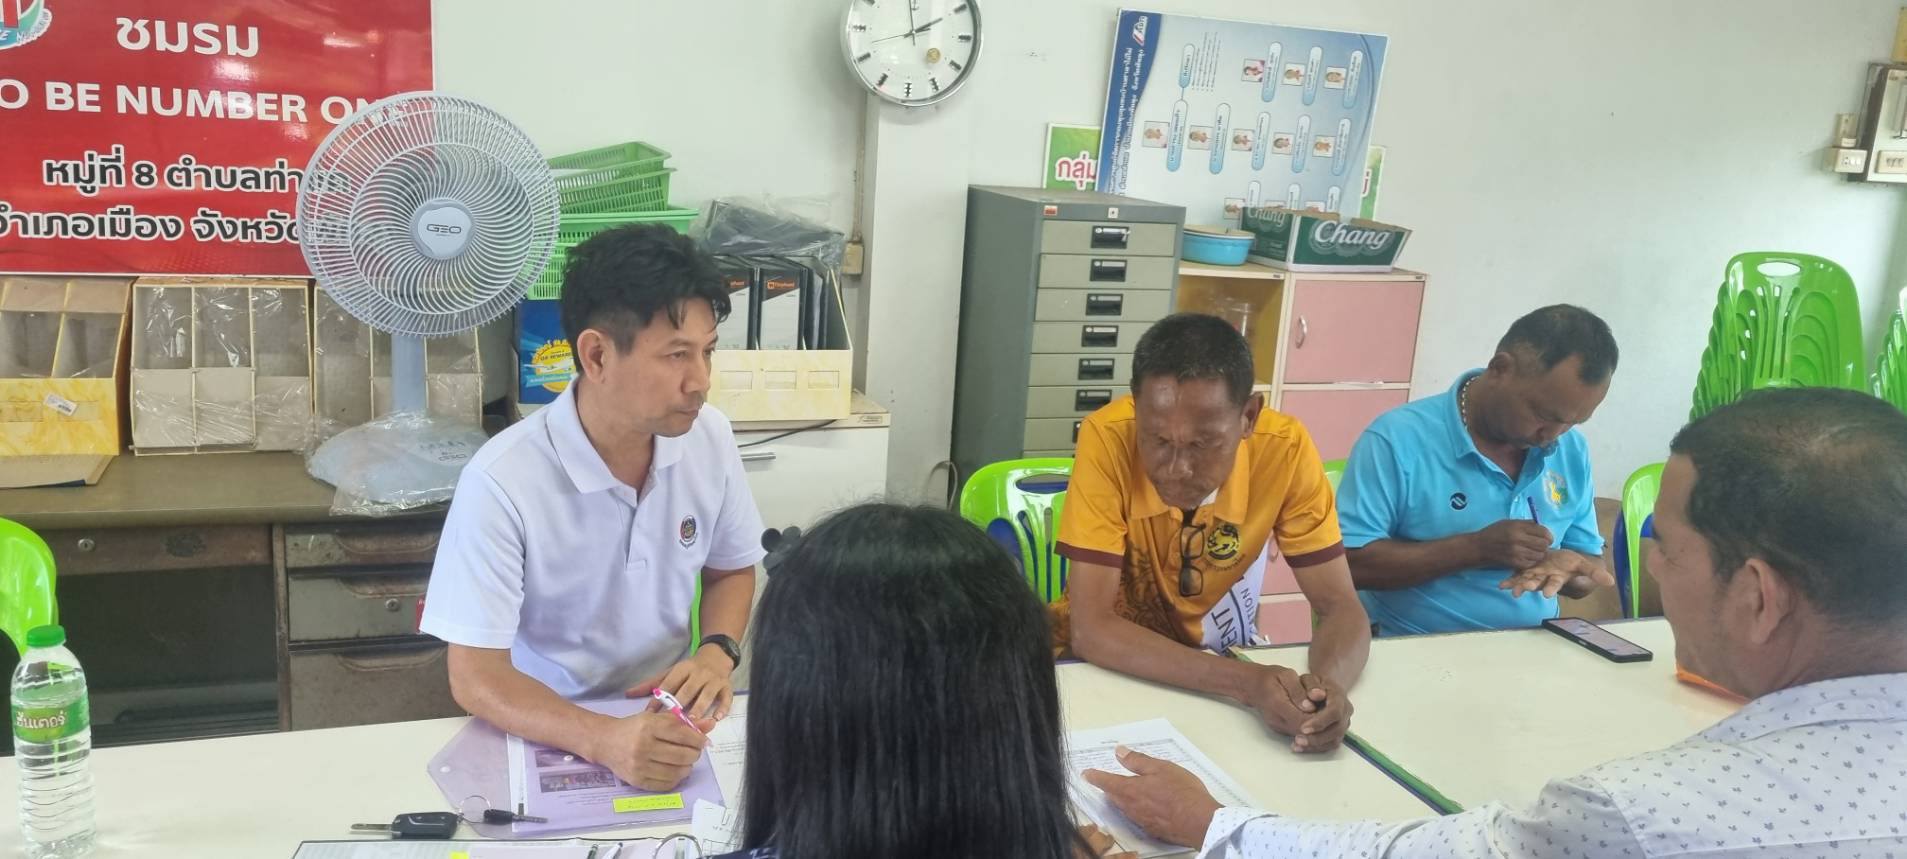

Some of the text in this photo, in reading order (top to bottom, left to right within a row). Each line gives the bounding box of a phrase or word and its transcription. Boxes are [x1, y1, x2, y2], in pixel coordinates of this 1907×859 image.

[115, 17, 260, 58] ชมรม
[45, 81, 101, 113] BE
[116, 84, 309, 123] NUMBER
[44, 145, 124, 196] หมู่ที่
[133, 162, 157, 188] 8
[426, 223, 462, 234] GEO
[1314, 220, 1391, 250] Chang
